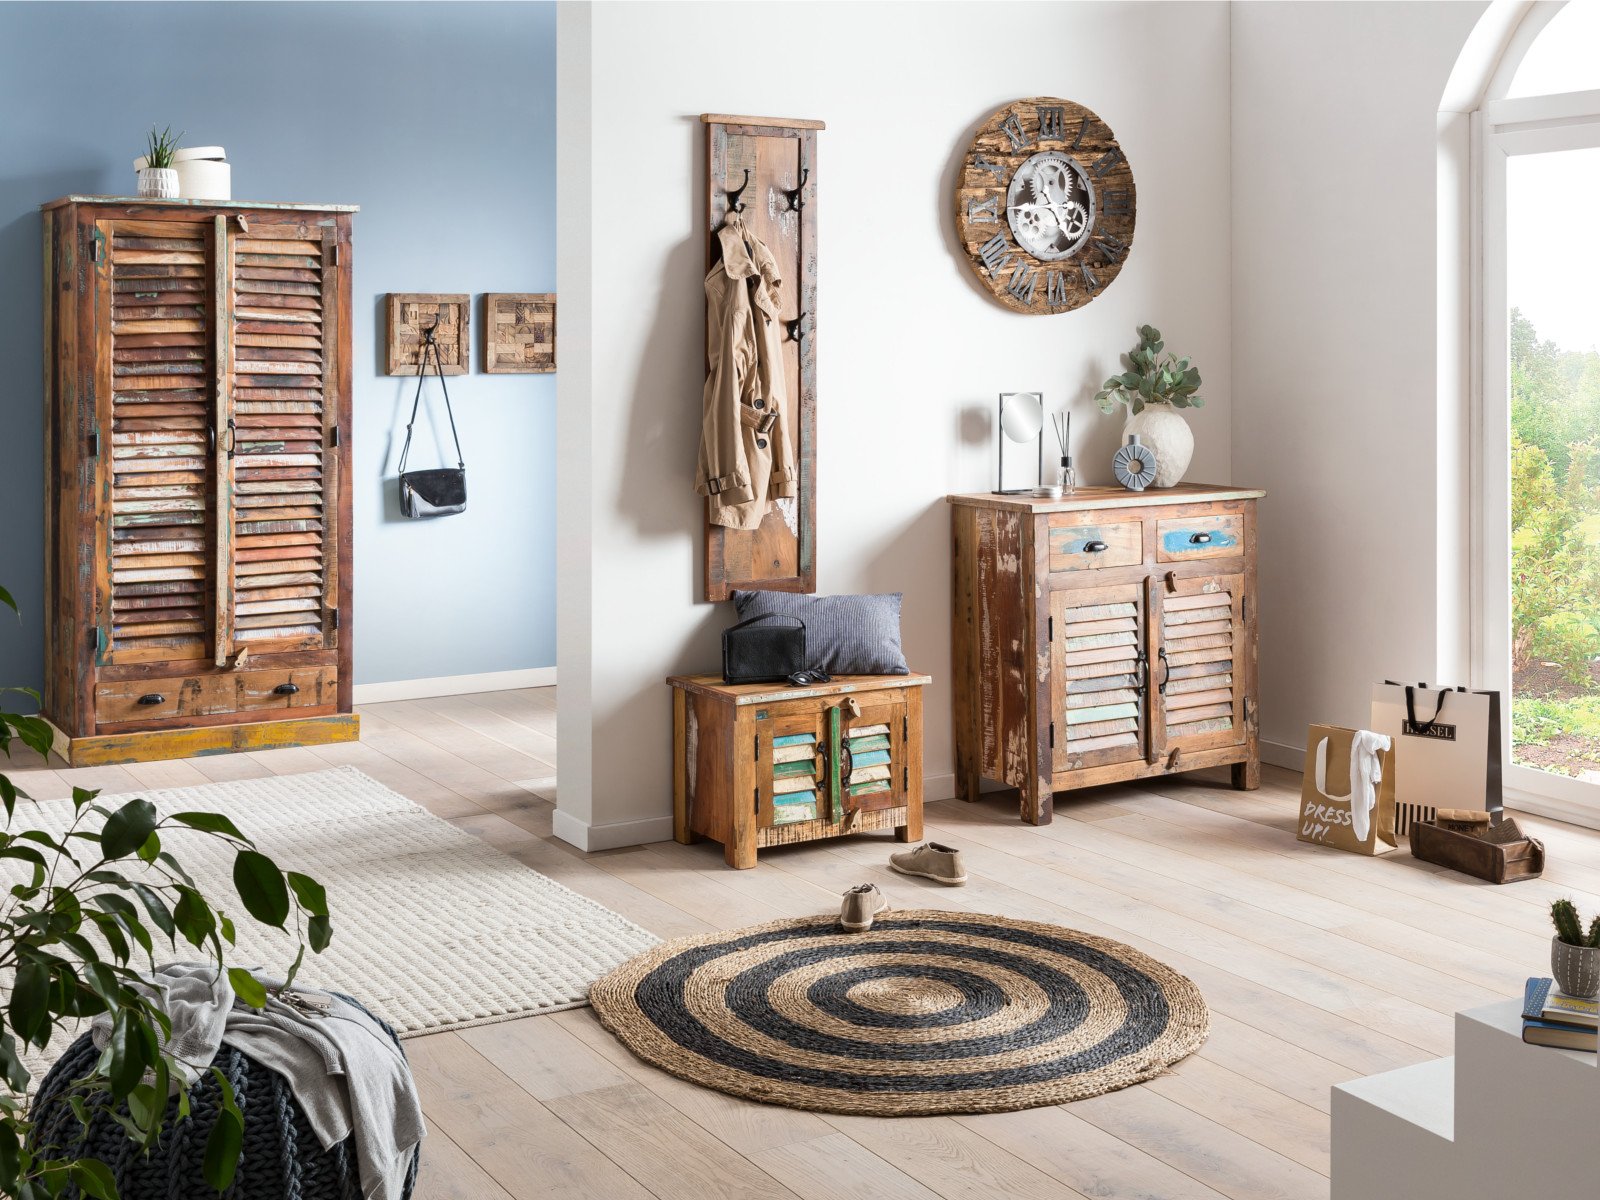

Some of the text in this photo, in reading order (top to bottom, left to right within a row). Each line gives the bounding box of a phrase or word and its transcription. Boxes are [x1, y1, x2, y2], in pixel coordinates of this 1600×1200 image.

[1406, 722, 1453, 738] SEL
[1304, 801, 1352, 826] DRESS
[1302, 820, 1330, 841] UP!
